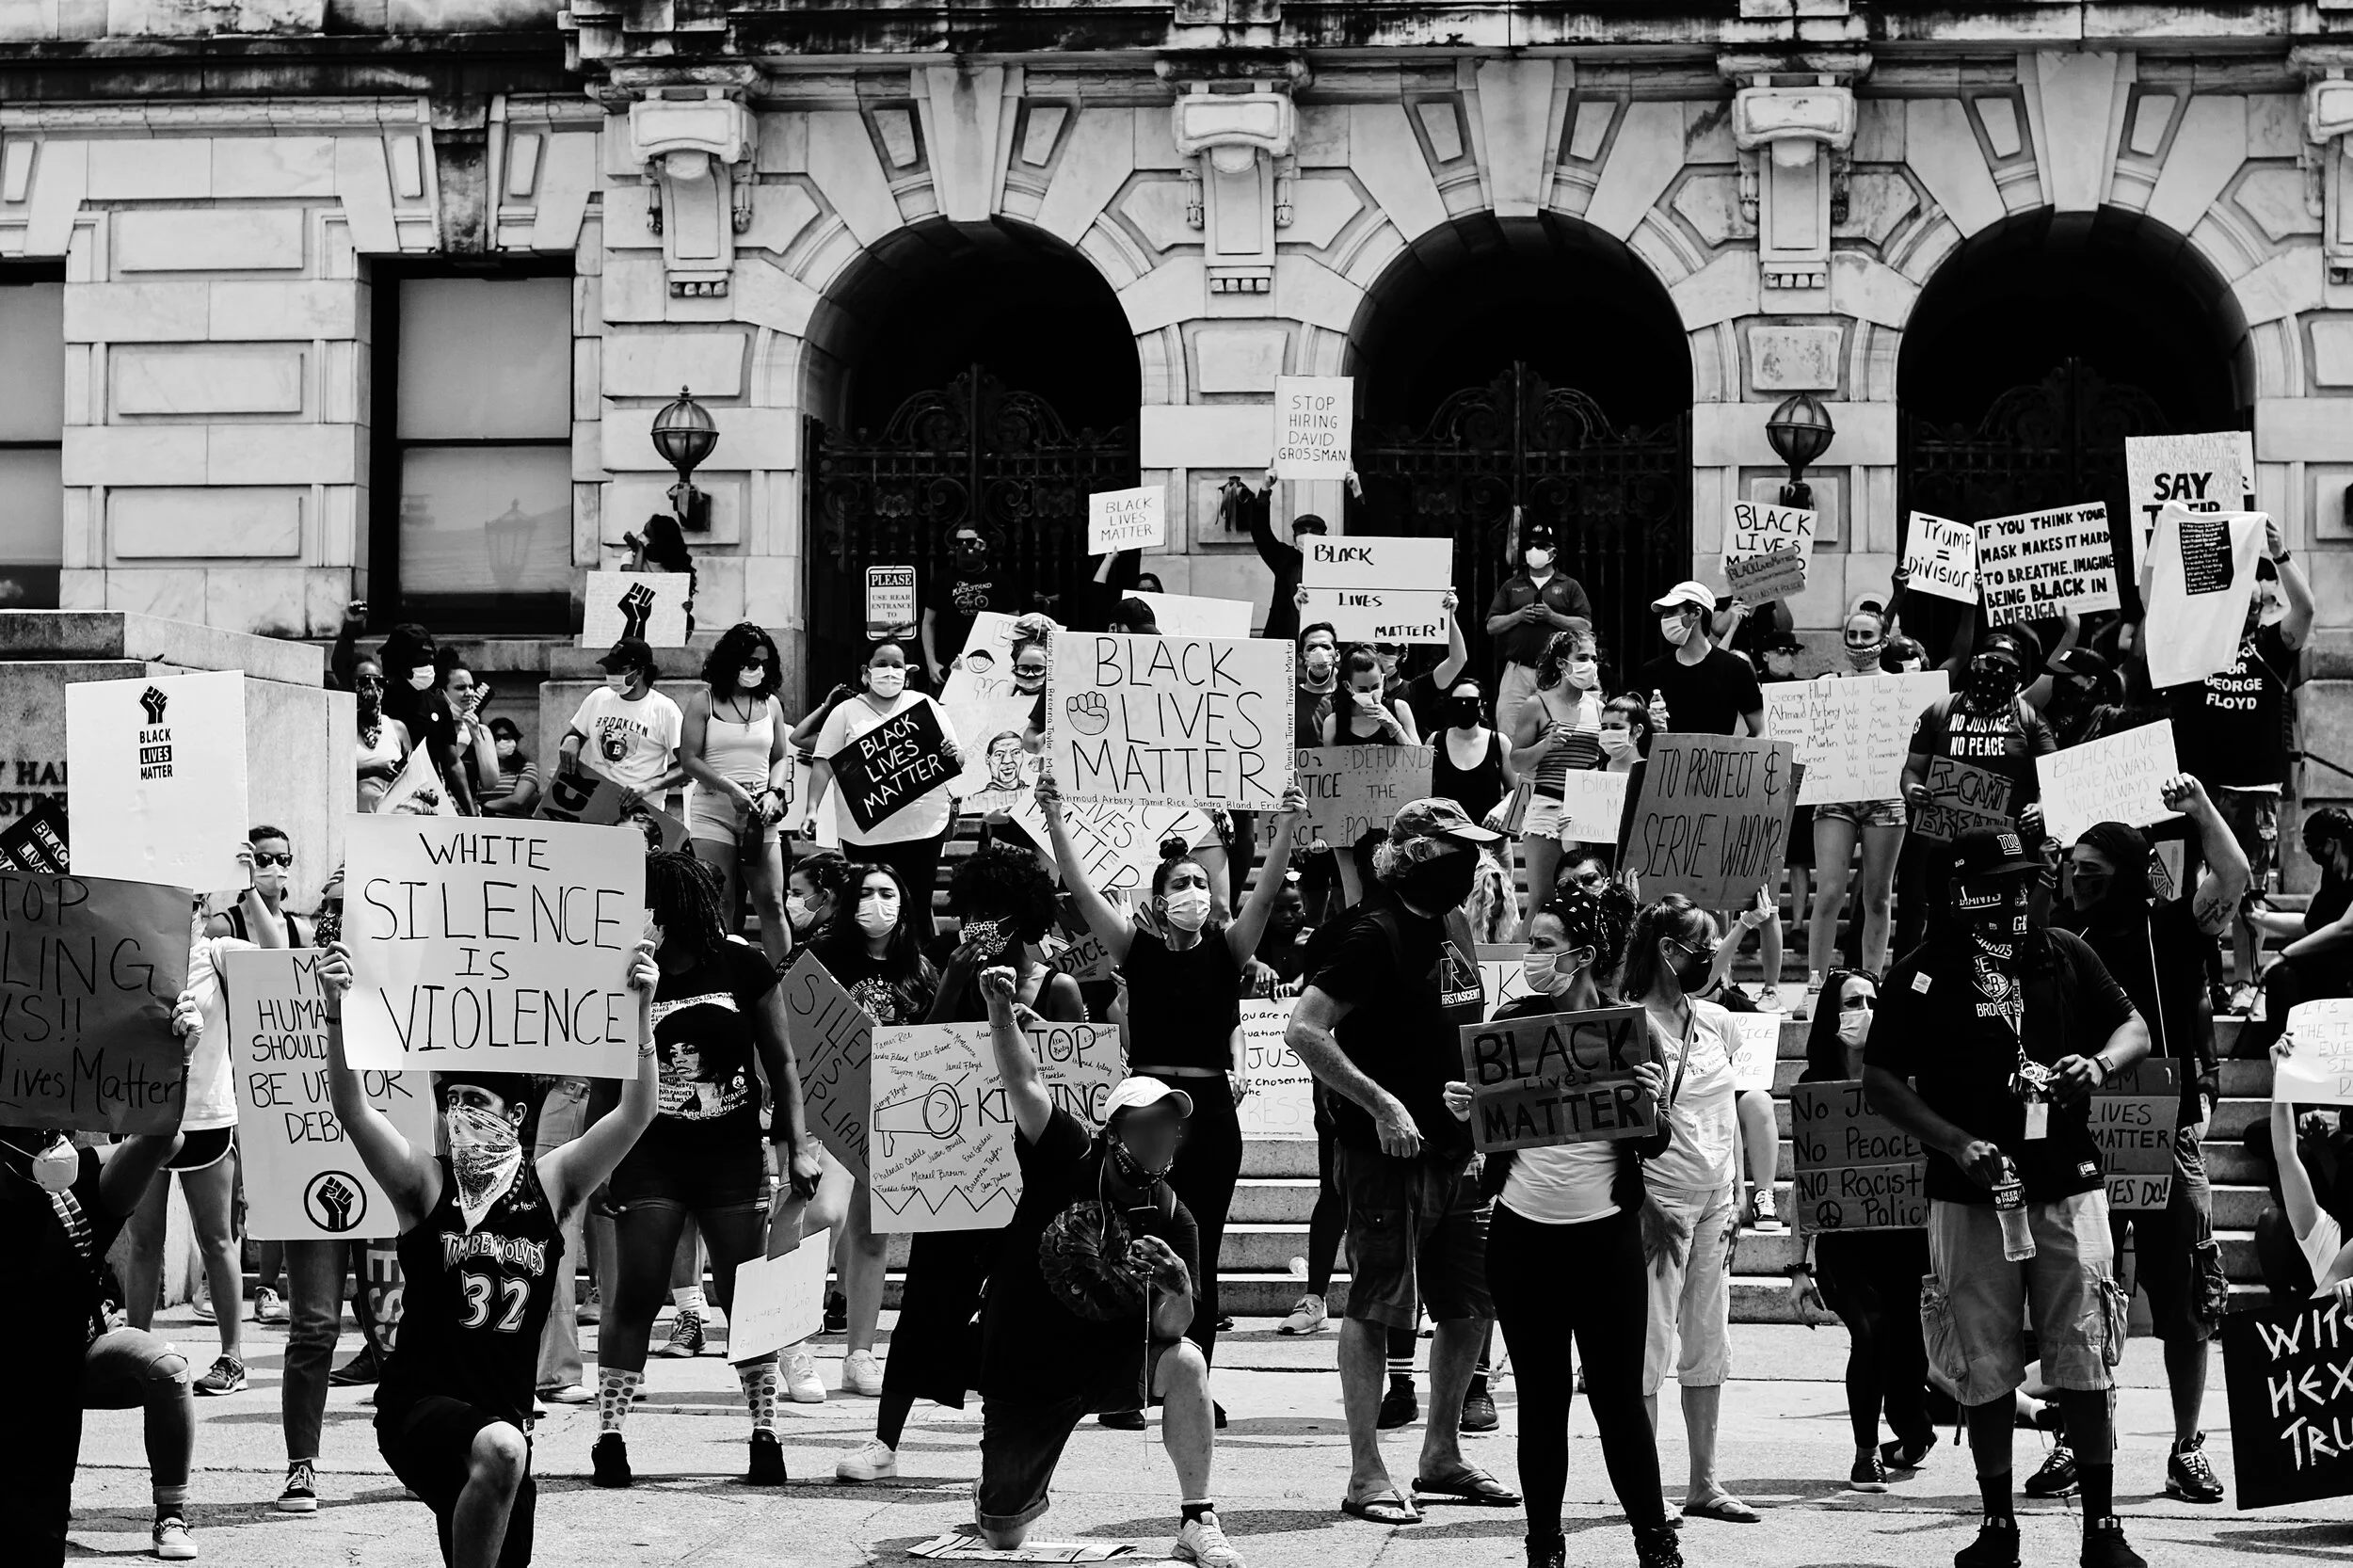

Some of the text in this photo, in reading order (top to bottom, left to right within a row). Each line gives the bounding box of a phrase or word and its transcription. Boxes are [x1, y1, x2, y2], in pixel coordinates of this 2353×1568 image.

[1292, 395, 1336, 410] STOP
[1289, 414, 1337, 428] HIRING
[1289, 431, 1335, 446] DAVID
[2153, 472, 2213, 501] SAY
[1106, 497, 1152, 513] BLACK
[1111, 512, 1145, 526] LIVES
[1734, 504, 1811, 536] BLACK
[1919, 518, 1972, 556] Trump
[1978, 508, 2106, 539] IF YOU THINK YOUR
[1314, 544, 1374, 565] BLACK
[1980, 531, 2110, 564] MASK MAKES IT HARD
[872, 574, 912, 585] PLEASE
[1909, 556, 1974, 593] Division
[1984, 571, 2004, 585] TO
[1338, 593, 1383, 607] LIVES
[1986, 588, 2025, 608] BEING
[2030, 578, 2086, 602] BLACK
[2091, 577, 2107, 593] IN
[1993, 601, 2057, 627] AMERICA
[1096, 637, 1242, 688] BLACK
[1287, 675, 1295, 707] Trayvon
[2204, 674, 2263, 692] GEORGE
[1047, 688, 1055, 726] Breonna
[1810, 701, 1840, 720] Arbery
[2206, 693, 2257, 710] FLOYD
[596, 716, 648, 738] BROOKLYN
[1121, 691, 1262, 749] LIVES
[1810, 718, 1835, 735] Taylor
[1949, 713, 2011, 733] NO JUSTICE
[139, 728, 171, 744] BLACK
[613, 744, 622, 755] B
[860, 713, 920, 760] BLACK
[1047, 727, 1055, 749] Taylor
[1807, 735, 1838, 749] Martin
[1950, 736, 2006, 756] NO PEACE
[142, 746, 169, 763] LIVES
[865, 739, 920, 782] LIVES
[1285, 742, 1293, 771] Pamela
[1353, 747, 1432, 770] DEFUND
[2053, 726, 2169, 778] BLACK LIVES
[140, 764, 173, 780] MATTER
[1072, 739, 1275, 800] MATTER
[1658, 748, 1680, 799] TO
[1685, 748, 1759, 799] PROTECT
[863, 754, 944, 818] MATTER
[1304, 773, 1398, 799] TICE THE
[1140, 797, 1282, 810] Tamir Sandra Eric
[32, 820, 70, 869] BLAC
[419, 833, 551, 871] WHITE
[1638, 812, 1782, 879] SERVE WHOM?
[0, 877, 89, 925] TOP
[364, 878, 625, 951] SILENCE
[3, 930, 156, 996] LING
[456, 947, 509, 981] IS
[258, 999, 328, 1032] HUMA
[379, 984, 626, 1052] VIOLENCE
[790, 973, 871, 1069] SILE
[2297, 1023, 2325, 1039] THE
[914, 1048, 933, 1061] Oscar
[1023, 1025, 1096, 1068] TOP
[1474, 1017, 1633, 1086] BLACK
[70, 1046, 183, 1115] Matter
[249, 1073, 293, 1108] BE
[364, 1069, 412, 1099] OR
[722, 1085, 749, 1103] WANTED
[1524, 1072, 1592, 1091] Lives
[977, 1083, 1111, 1127] KIING
[1485, 1084, 1645, 1144] MATTER
[1792, 1092, 1829, 1122] No
[2088, 1103, 2152, 1126] IVES
[1794, 1131, 1827, 1164] No
[2090, 1128, 2170, 1149] MATTER
[937, 1169, 967, 1180] Brown
[1799, 1163, 1923, 1202] NO Racist
[2001, 1190, 2018, 1198] DEER
[2141, 1176, 2169, 1207] DO!
[1861, 1193, 1929, 1226] Polic
[458, 1270, 531, 1333] 32
[2255, 1303, 2353, 1362] WIT
[2281, 1416, 2353, 1471] TRU
